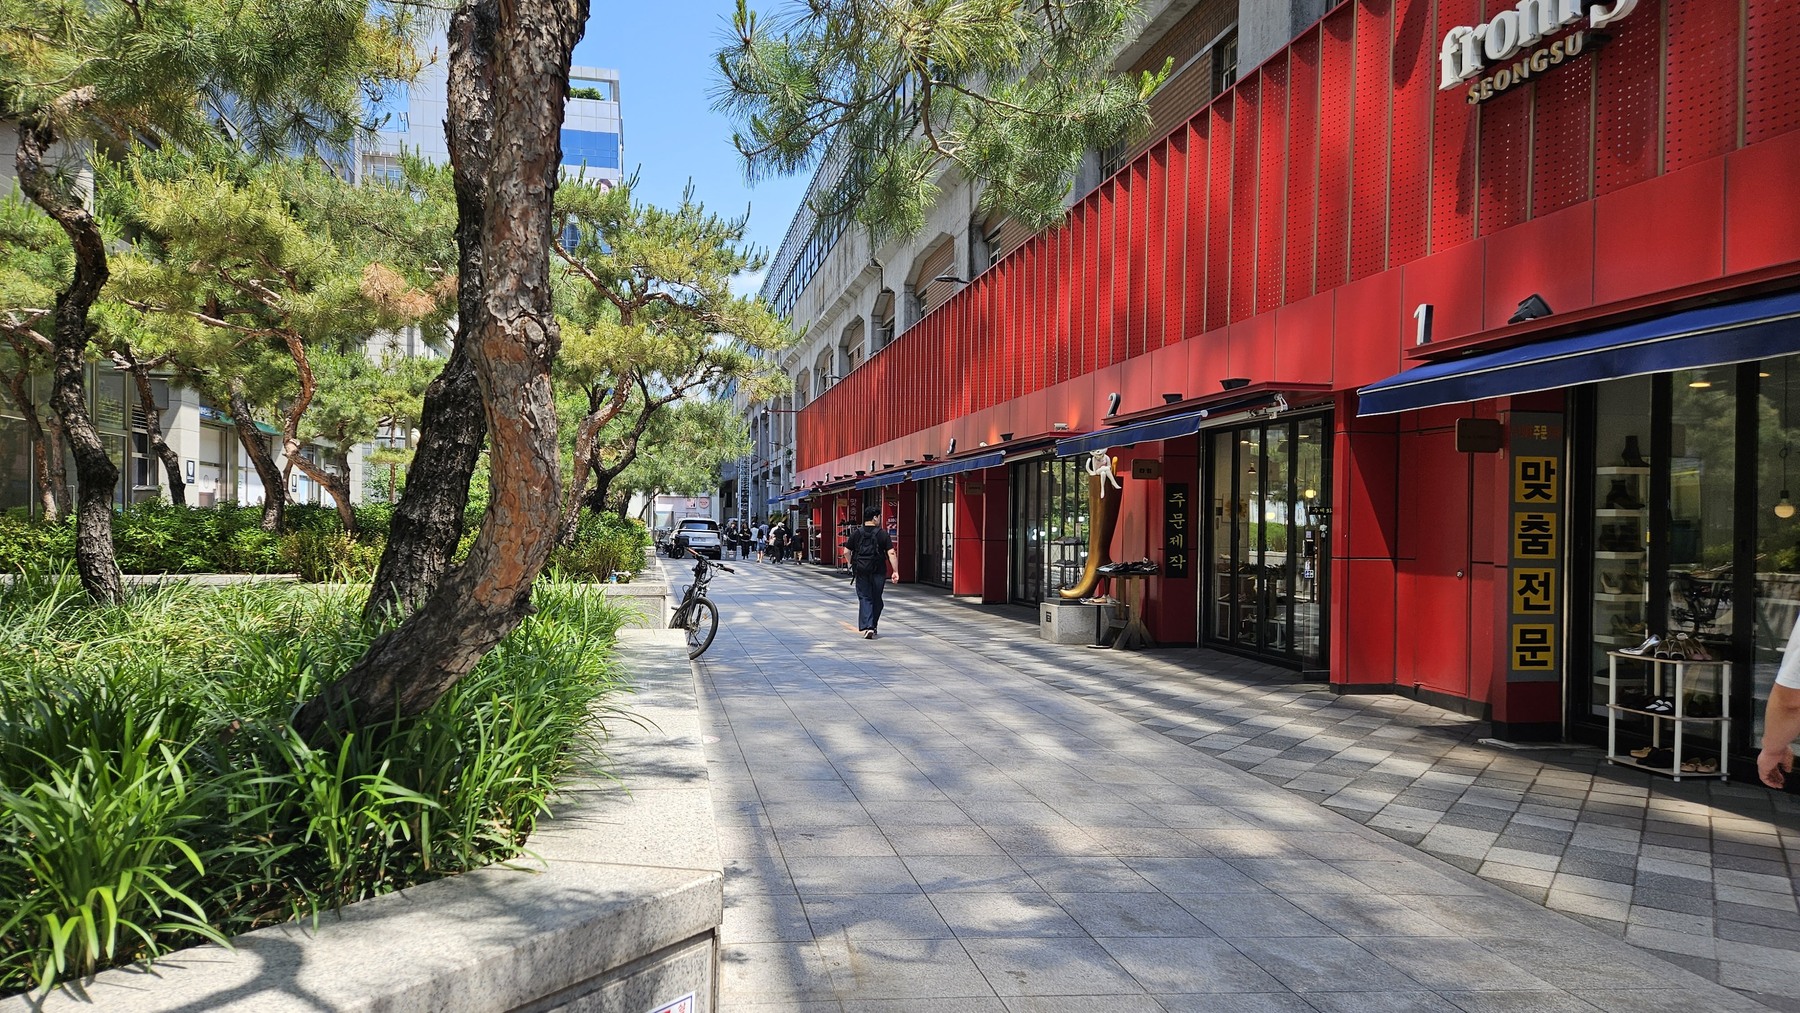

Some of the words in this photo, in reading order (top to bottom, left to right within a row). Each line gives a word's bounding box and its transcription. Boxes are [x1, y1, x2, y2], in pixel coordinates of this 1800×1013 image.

[1468, 31, 1583, 104] SEONGSU
[1413, 304, 1432, 345] 1
[1107, 392, 1120, 417] 2
[1169, 492, 1186, 570] 주문제작
[1515, 461, 1556, 666] 맞춤전문
